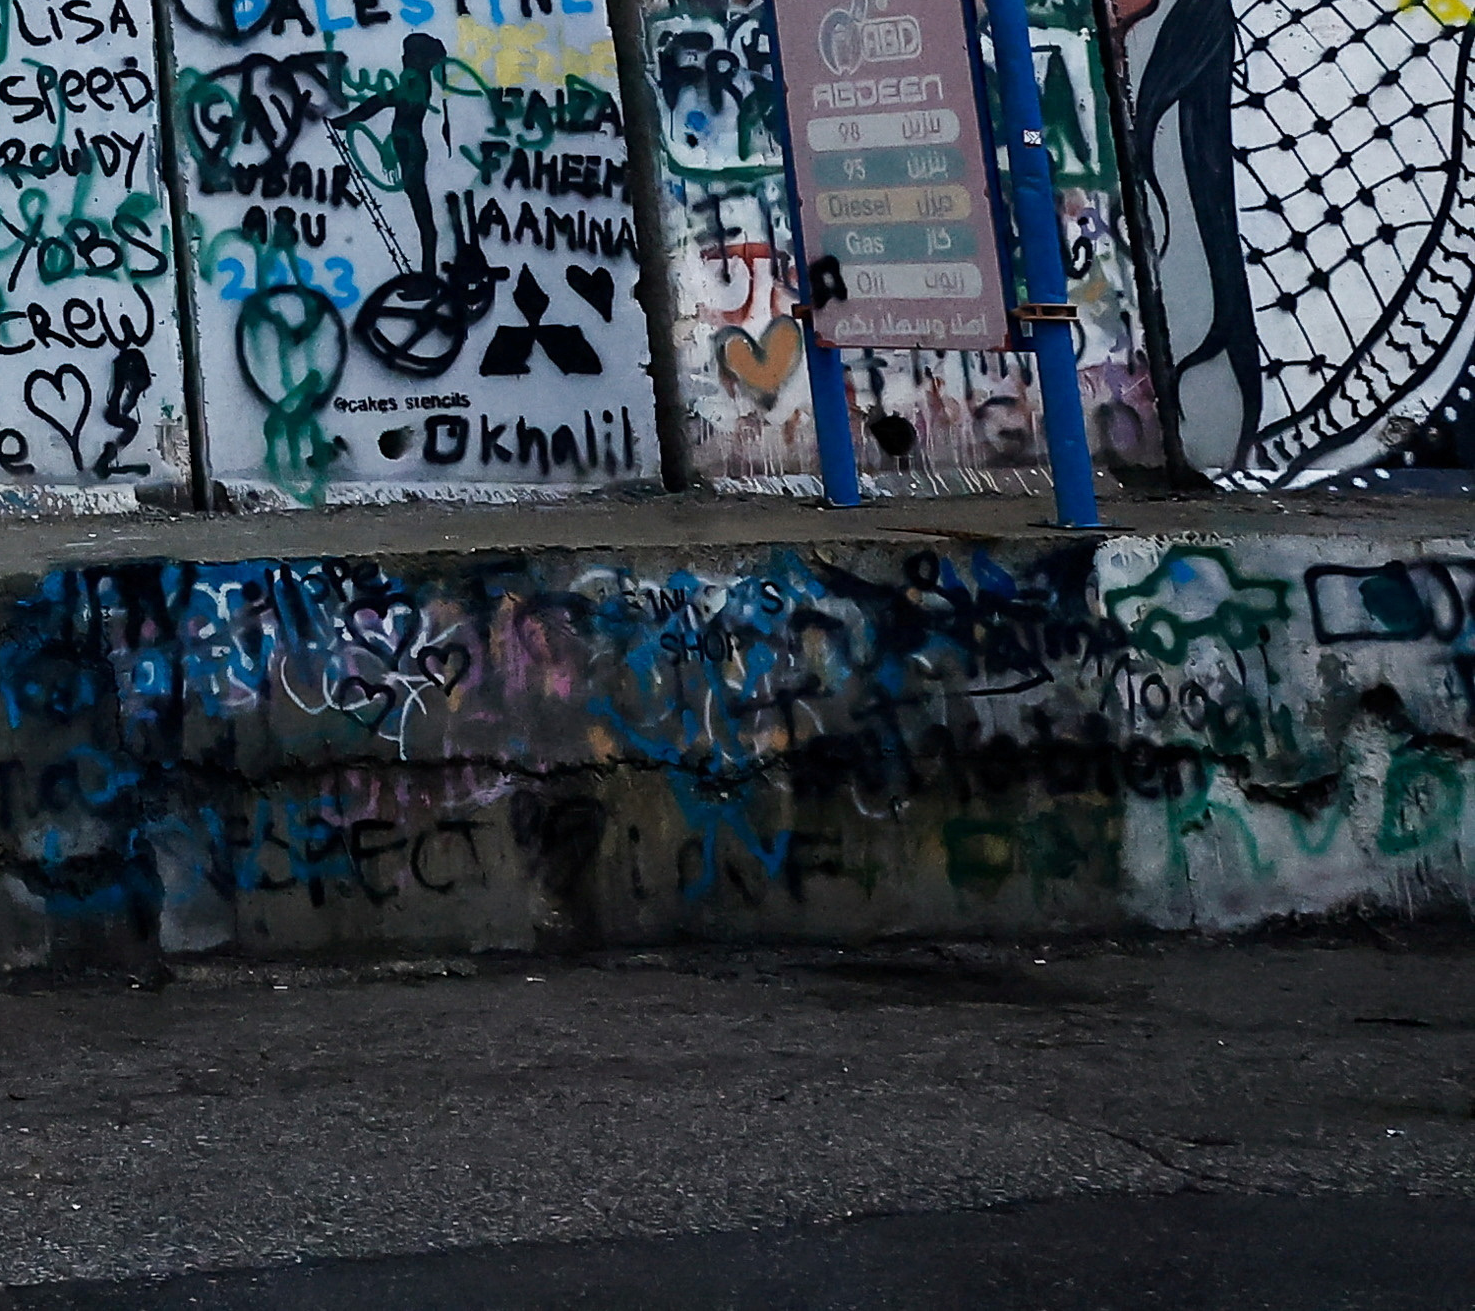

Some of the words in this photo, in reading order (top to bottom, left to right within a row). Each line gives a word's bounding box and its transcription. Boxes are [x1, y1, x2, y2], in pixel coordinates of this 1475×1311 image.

[828, 191, 893, 218] Diesel
[845, 231, 885, 255] Gas
[856, 271, 887, 295] Oil
